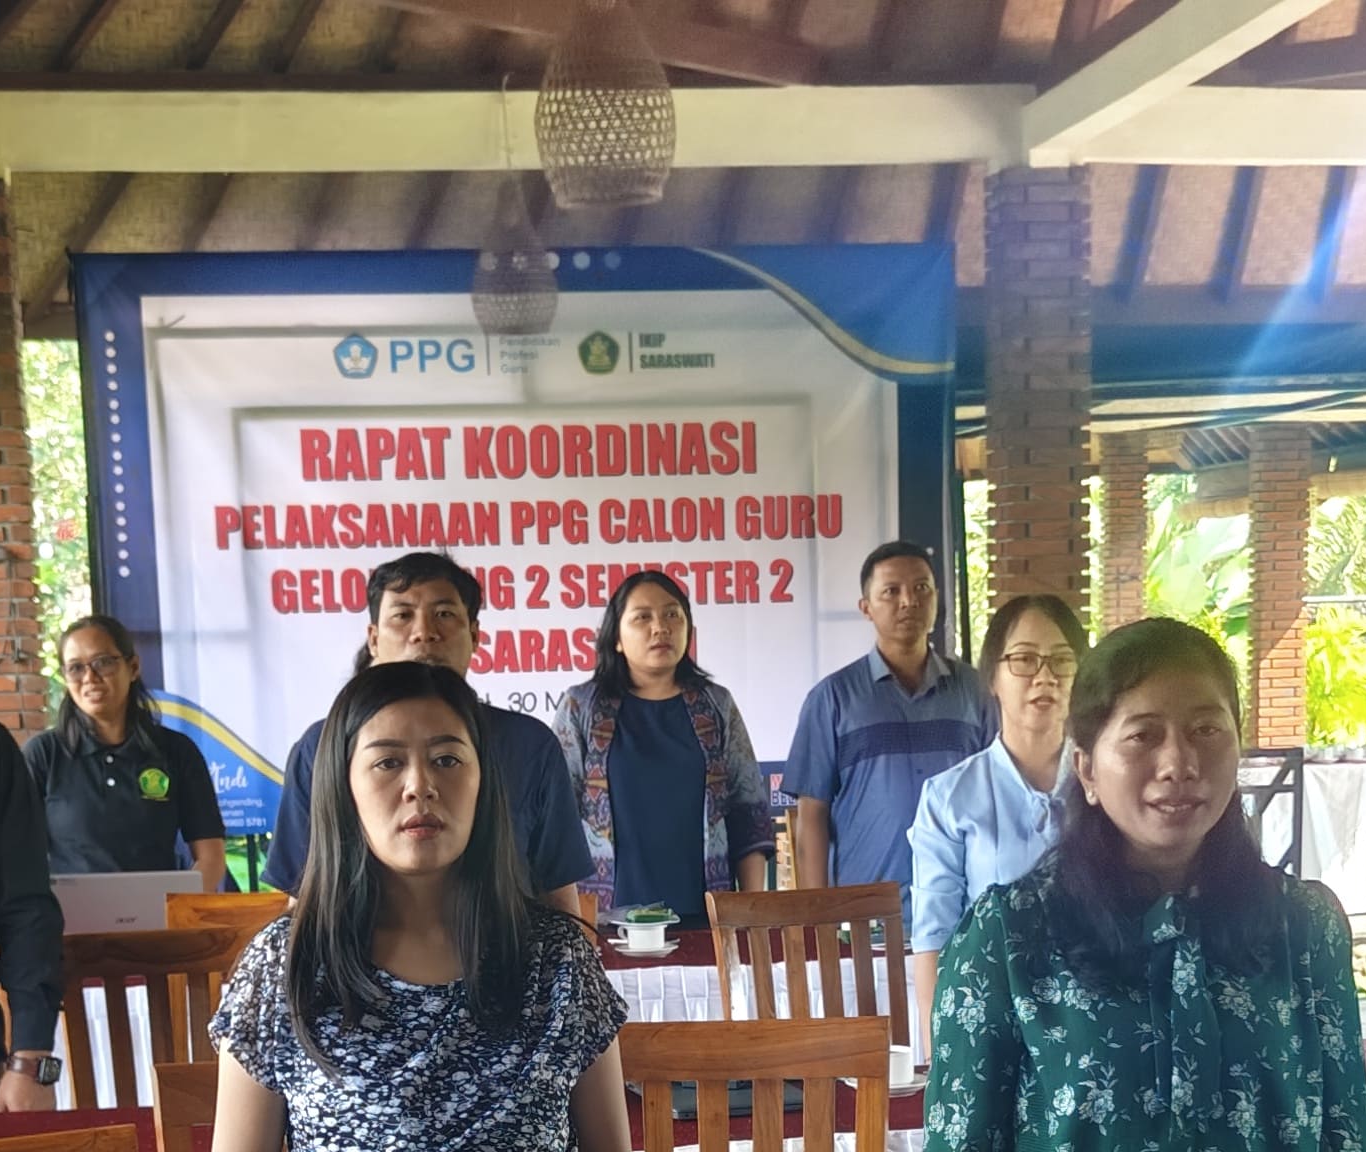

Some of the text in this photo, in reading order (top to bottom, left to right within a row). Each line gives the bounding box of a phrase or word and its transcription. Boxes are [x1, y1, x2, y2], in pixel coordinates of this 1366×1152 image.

[390, 338, 476, 373] PPG
[640, 353, 715, 369] SARASWATI
[299, 421, 758, 481] RAPAT KOORDINASI
[214, 494, 843, 550] PELAKSANAAN PPG CALON GURU
[271, 565, 515, 614] GELOG
[525, 564, 550, 610] 2
[769, 559, 794, 603] 2
[508, 692, 537, 713] 30
